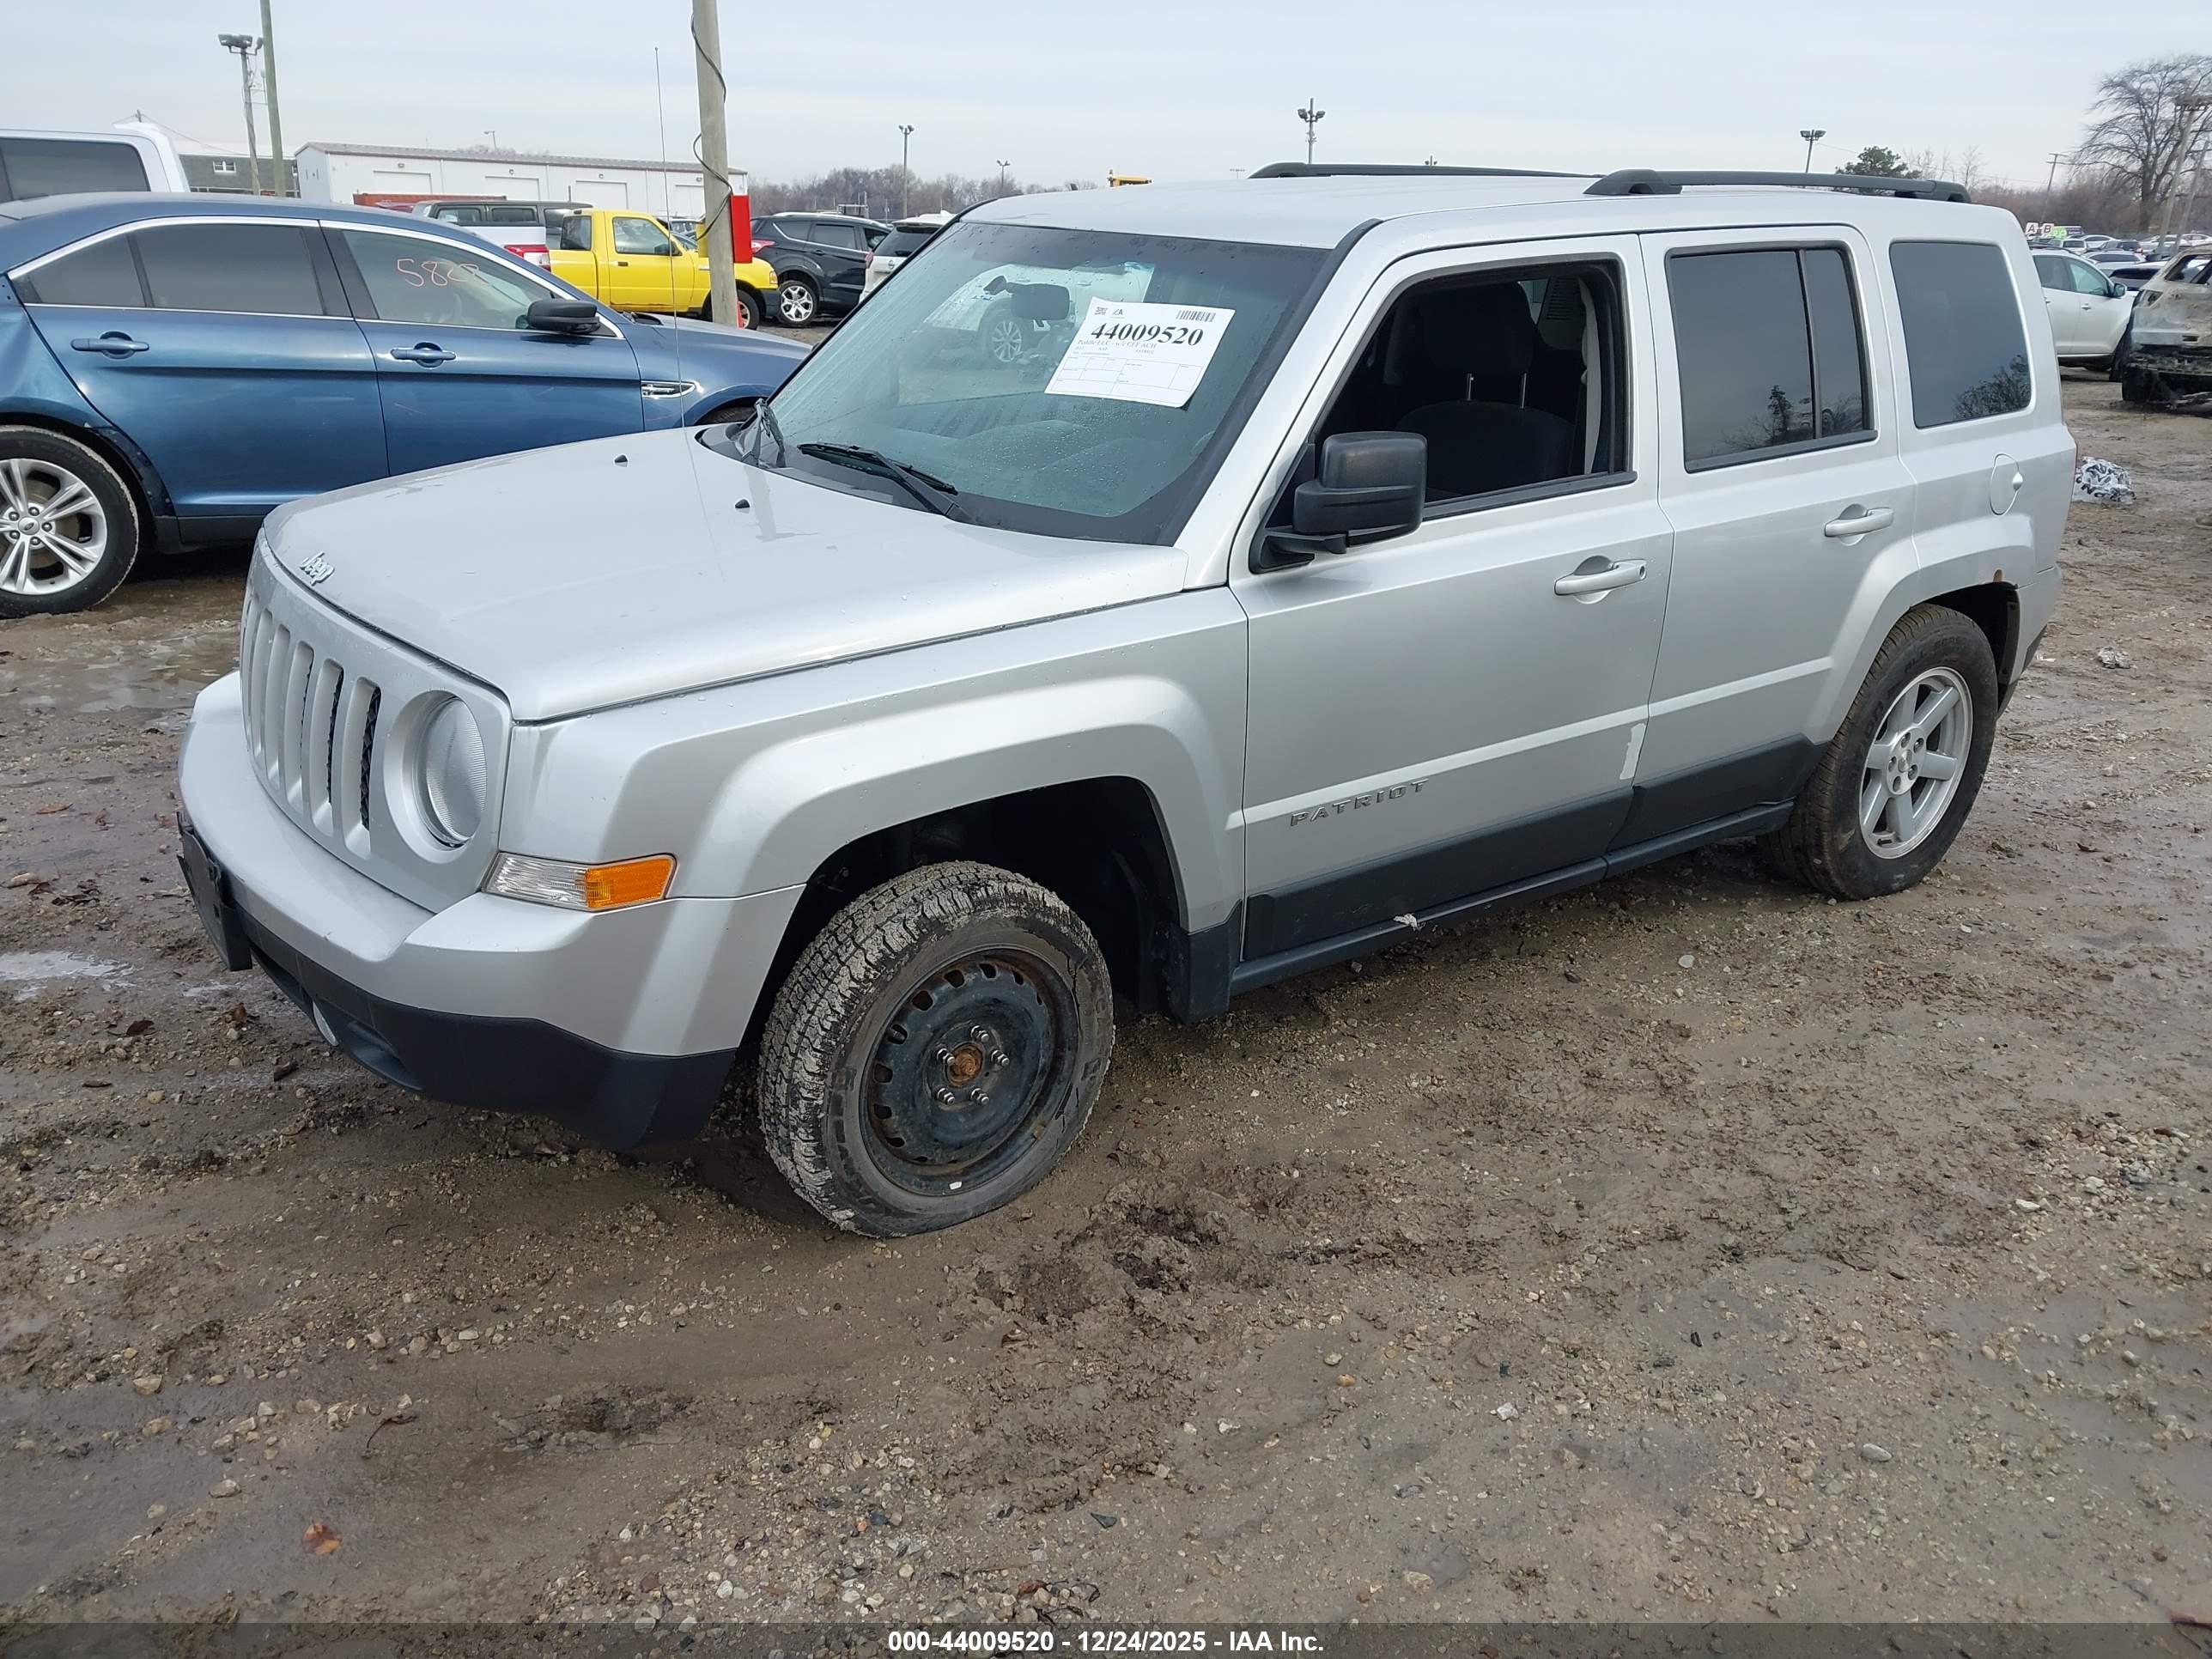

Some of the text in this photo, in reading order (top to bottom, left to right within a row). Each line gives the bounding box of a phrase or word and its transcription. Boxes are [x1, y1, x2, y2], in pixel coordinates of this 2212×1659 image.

[2027, 224, 2036, 233] A
[2043, 224, 2051, 234] B
[1091, 322, 1204, 346] 44009520
[301, 551, 335, 586] Jeep
[1290, 778, 1430, 827] PATRIOT
